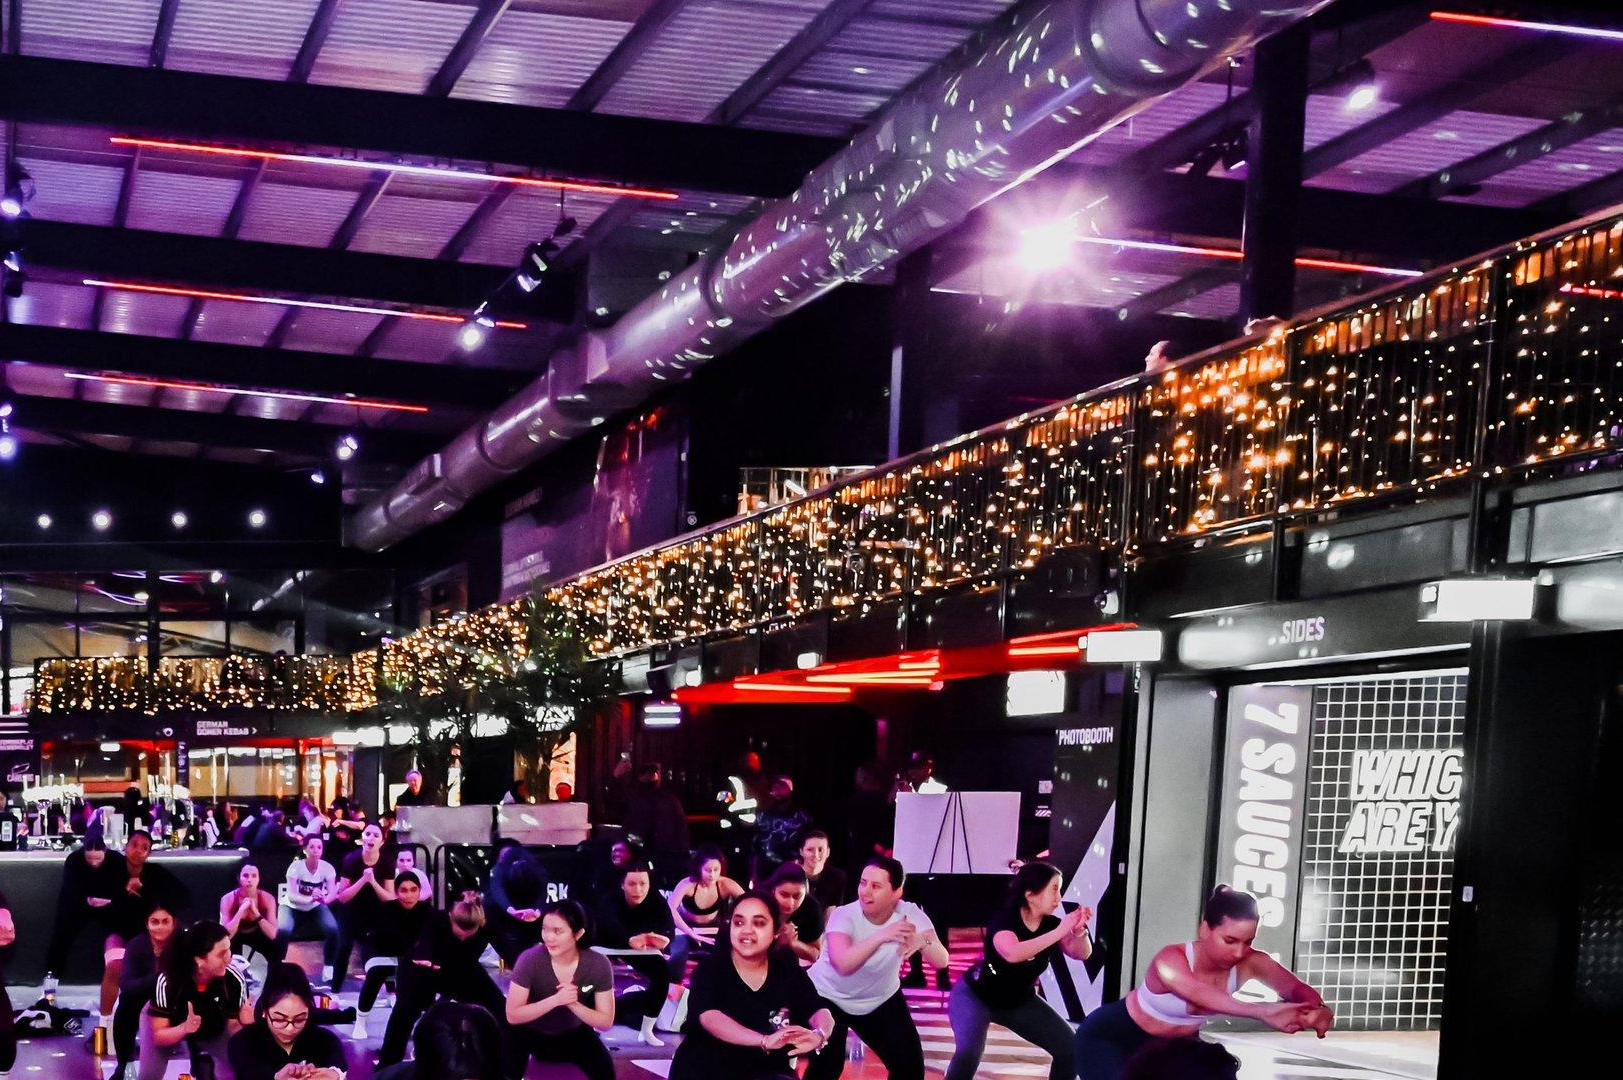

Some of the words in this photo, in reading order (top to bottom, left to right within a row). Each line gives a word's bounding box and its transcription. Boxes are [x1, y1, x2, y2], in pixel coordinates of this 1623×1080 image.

[1279, 616, 1325, 645] SIDES
[1244, 703, 1299, 735] 7
[1058, 726, 1115, 746] PHOTOBOOTH
